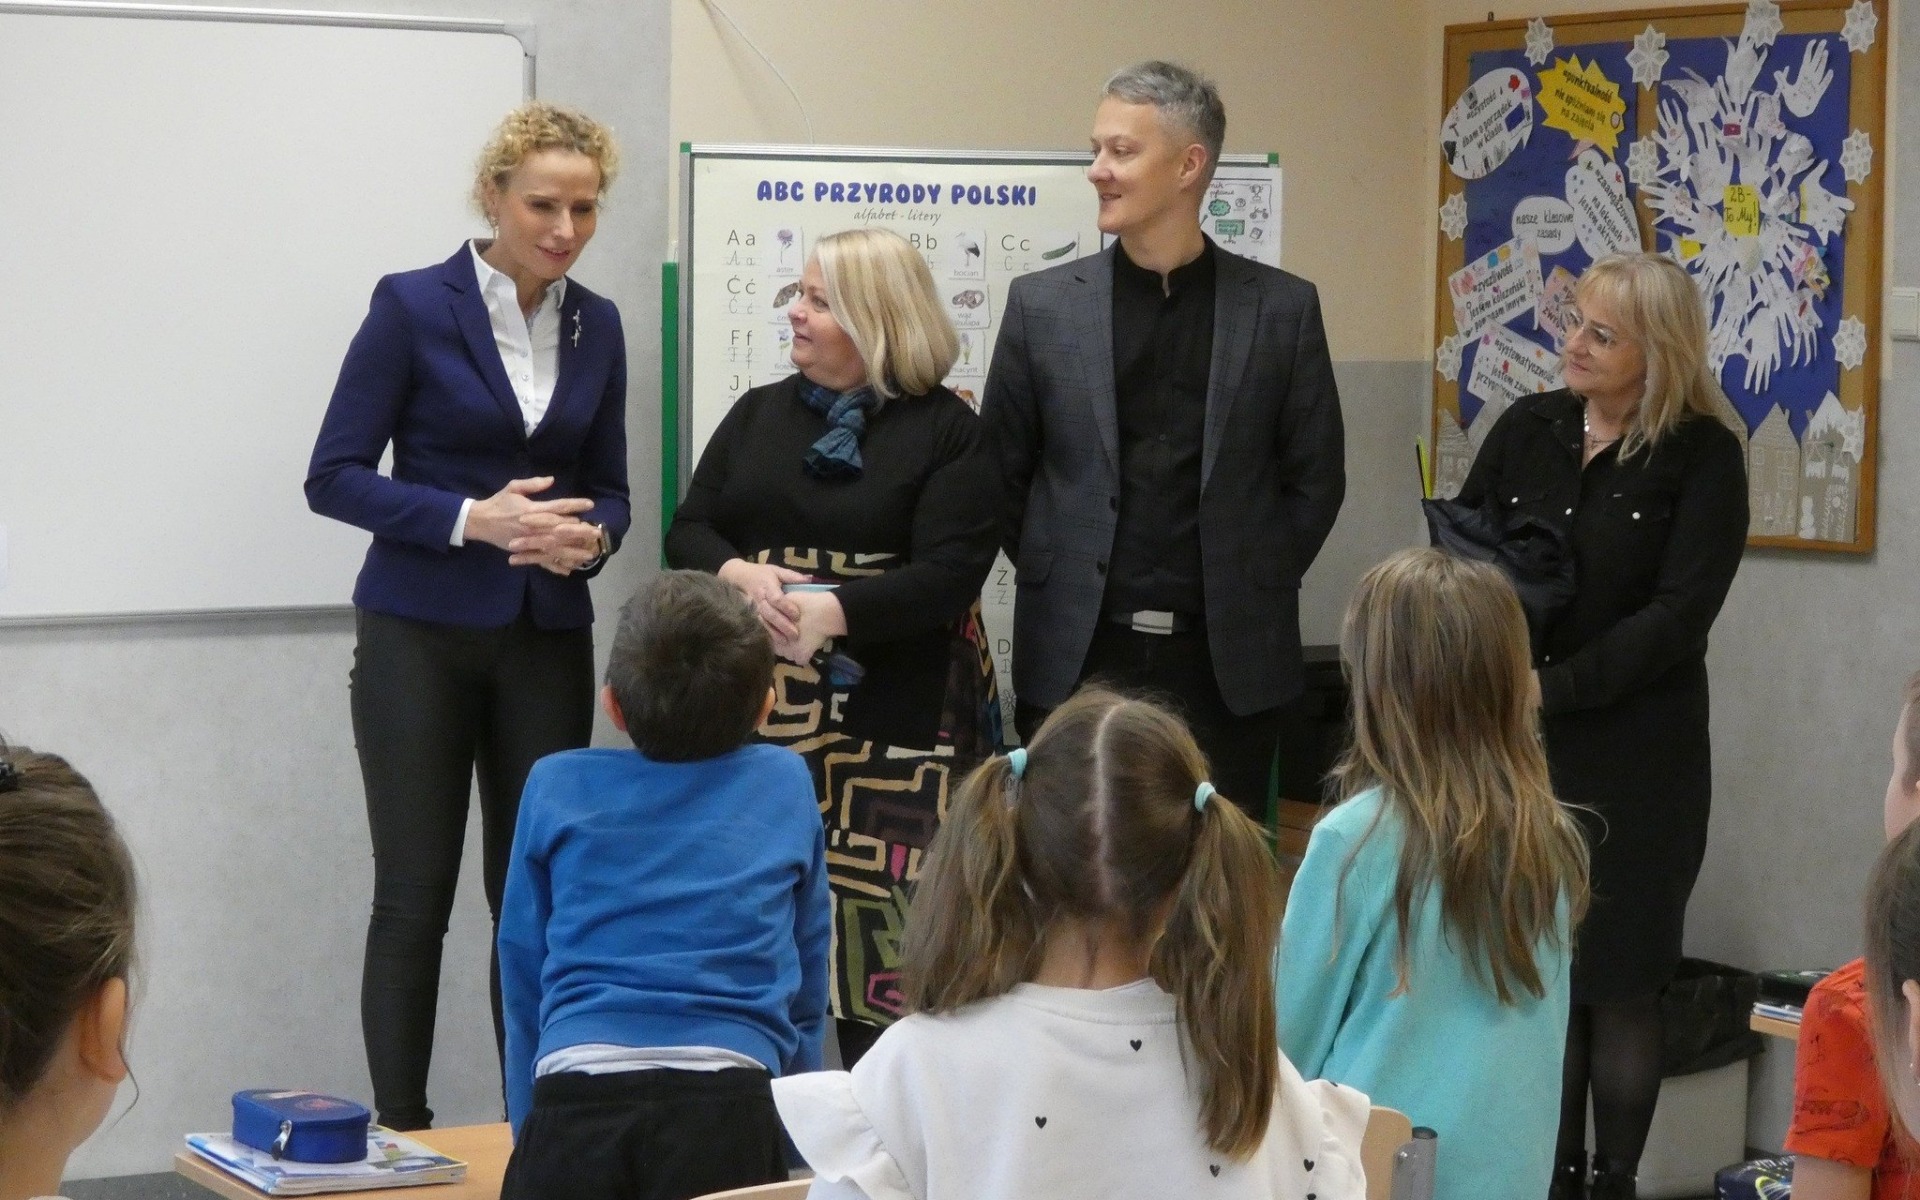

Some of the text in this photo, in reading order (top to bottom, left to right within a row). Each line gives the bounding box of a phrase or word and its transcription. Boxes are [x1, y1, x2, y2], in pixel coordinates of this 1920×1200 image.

[757, 180, 1037, 206] ABC PRZYRODY POLSKI
[853, 207, 897, 225] alfabet
[907, 208, 942, 226] litery
[1516, 209, 1574, 225] nasze klasowe
[1724, 206, 1734, 222] To
[1537, 229, 1562, 241] zasady
